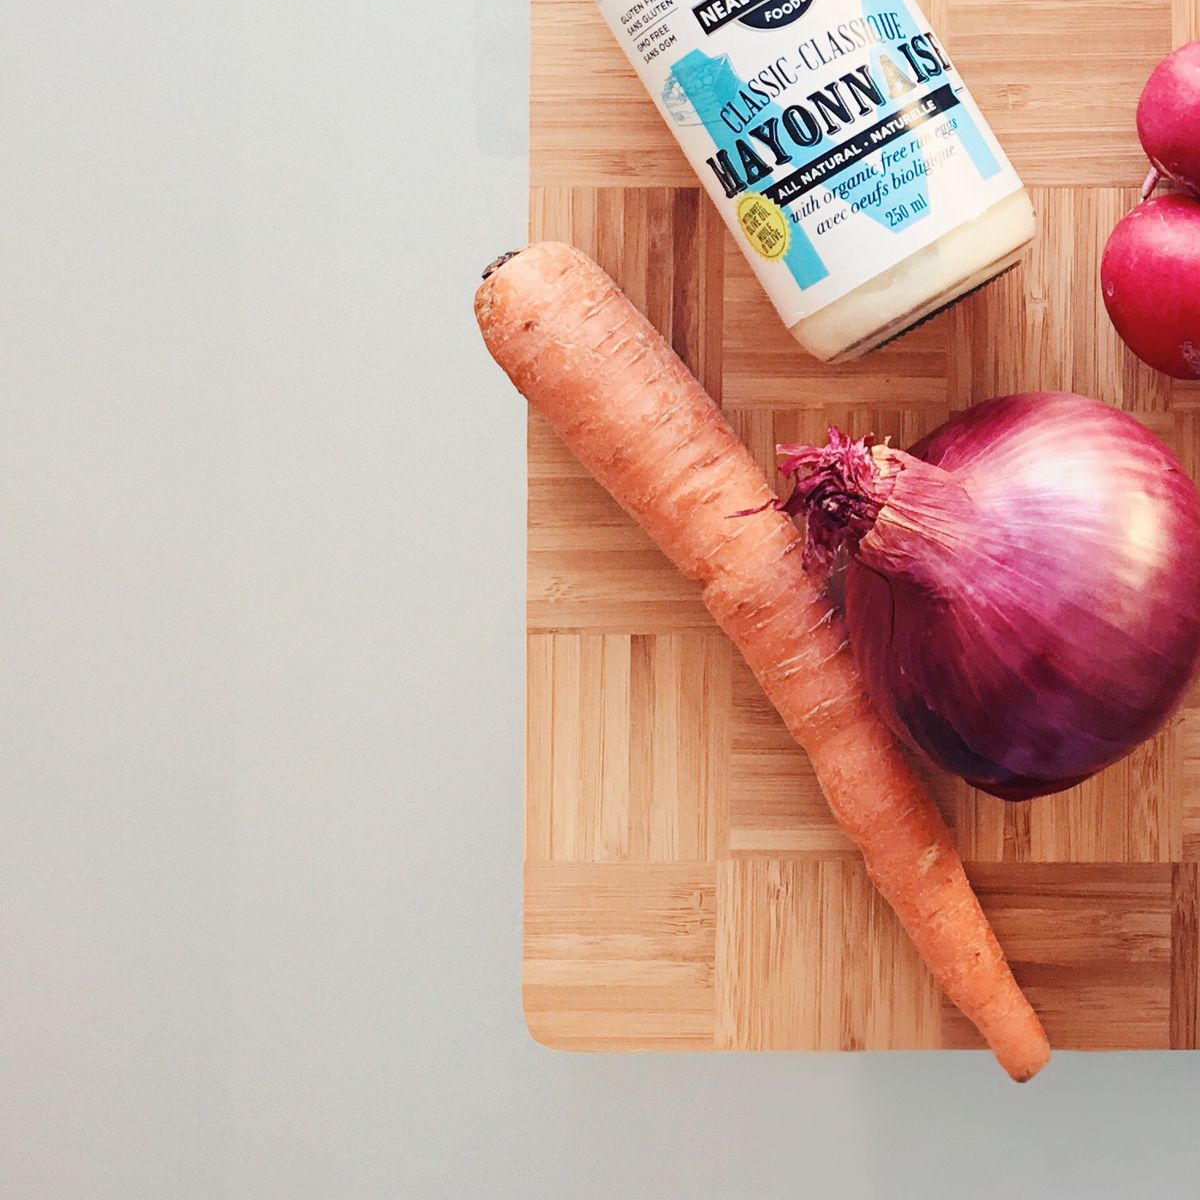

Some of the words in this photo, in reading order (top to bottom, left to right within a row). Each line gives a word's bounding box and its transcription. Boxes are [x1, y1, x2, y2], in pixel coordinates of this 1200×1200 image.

[620, 2, 645, 25] GLUTEN
[627, 20, 644, 37] SANS
[643, 48, 661, 65] SANS
[658, 35, 679, 52] OGM
[649, 24, 670, 43] FREE
[777, 185, 802, 200] ALL
[800, 146, 863, 187] NATURAL
[870, 99, 937, 144] NATURELLE
[789, 191, 822, 225] with
[822, 163, 880, 206] organic
[880, 145, 909, 180] free
[934, 117, 959, 141] eggs
[815, 207, 851, 237] avec
[850, 181, 890, 216] oeufs
[885, 203, 910, 229] 250
[911, 193, 929, 214] ml
